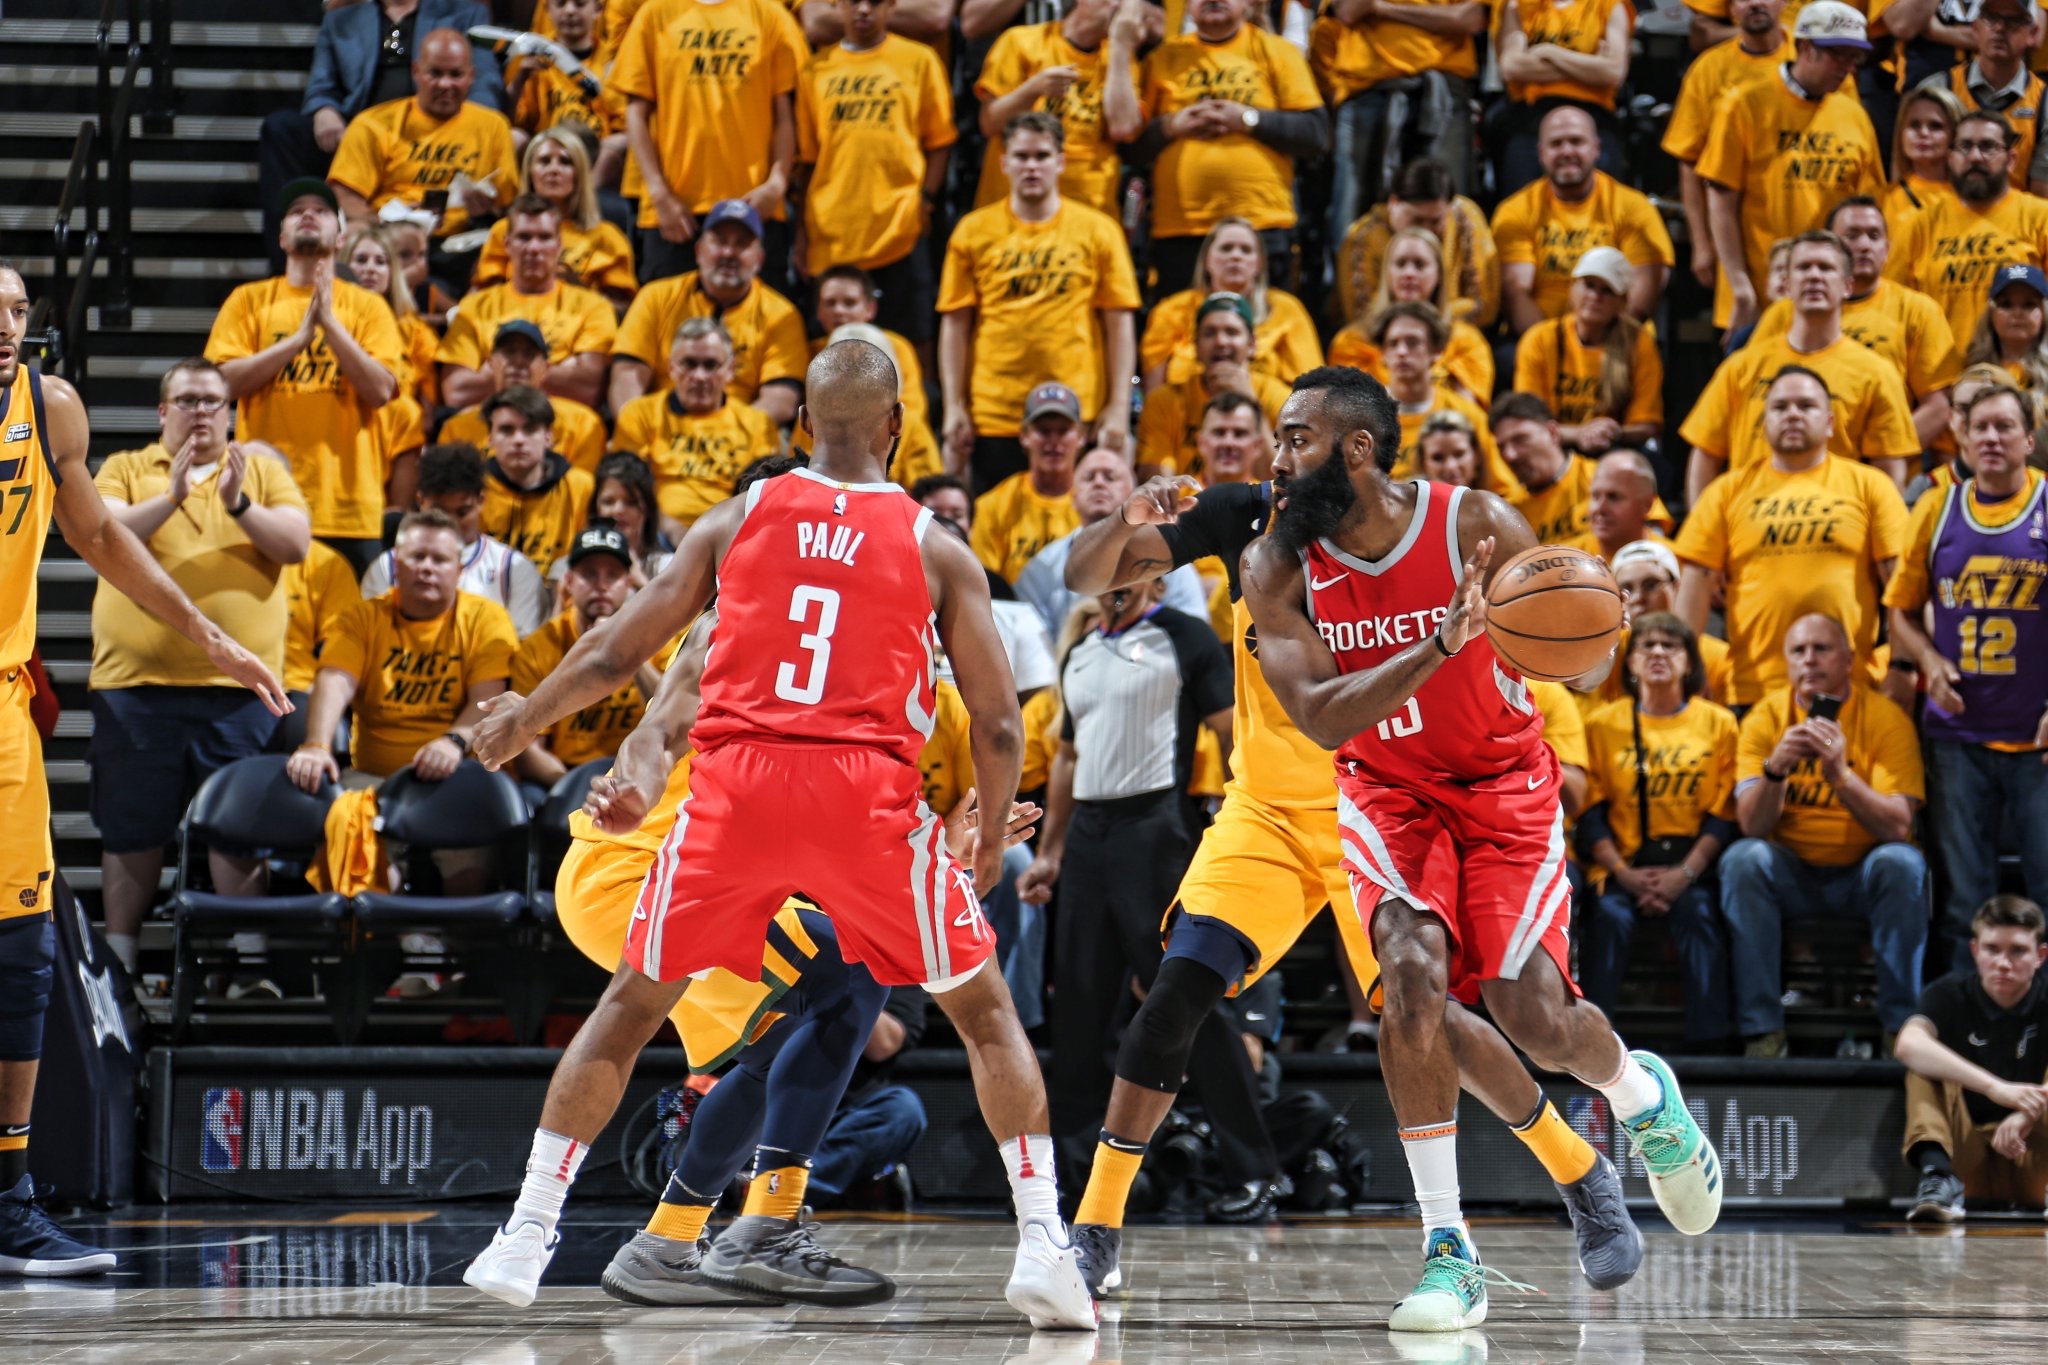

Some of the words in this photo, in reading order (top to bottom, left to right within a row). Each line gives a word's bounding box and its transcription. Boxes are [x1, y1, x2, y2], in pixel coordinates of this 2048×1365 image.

[679, 28, 739, 50] TAKE
[690, 54, 752, 78] NOTE
[824, 74, 884, 101] TAKE
[829, 99, 898, 124] NOTE
[408, 143, 465, 164] TAKE
[1776, 129, 1835, 153] TAKE
[412, 167, 466, 186] NOT
[1785, 157, 1857, 186] NOTE
[994, 247, 1057, 271] TAKE
[1932, 233, 1999, 263] TAKE
[1003, 271, 1073, 298] NOTE
[1940, 259, 2002, 284] NOT
[0, 484, 33, 536] 7
[1750, 495, 1823, 523] TAKE
[581, 530, 622, 550] SLC
[796, 521, 866, 567] PAUL
[1760, 518, 1843, 547] NOTE
[1316, 606, 1449, 654] ROCKETS
[774, 584, 841, 705] 3
[1959, 615, 2018, 676] 12
[382, 647, 445, 678] TAKE
[385, 676, 460, 705] NOTE
[570, 704, 637, 732] NOTE
[1618, 745, 1688, 770] TKE
[248, 1088, 347, 1170] NBA
[352, 1087, 433, 1185] App
[1720, 1097, 1799, 1195] App
